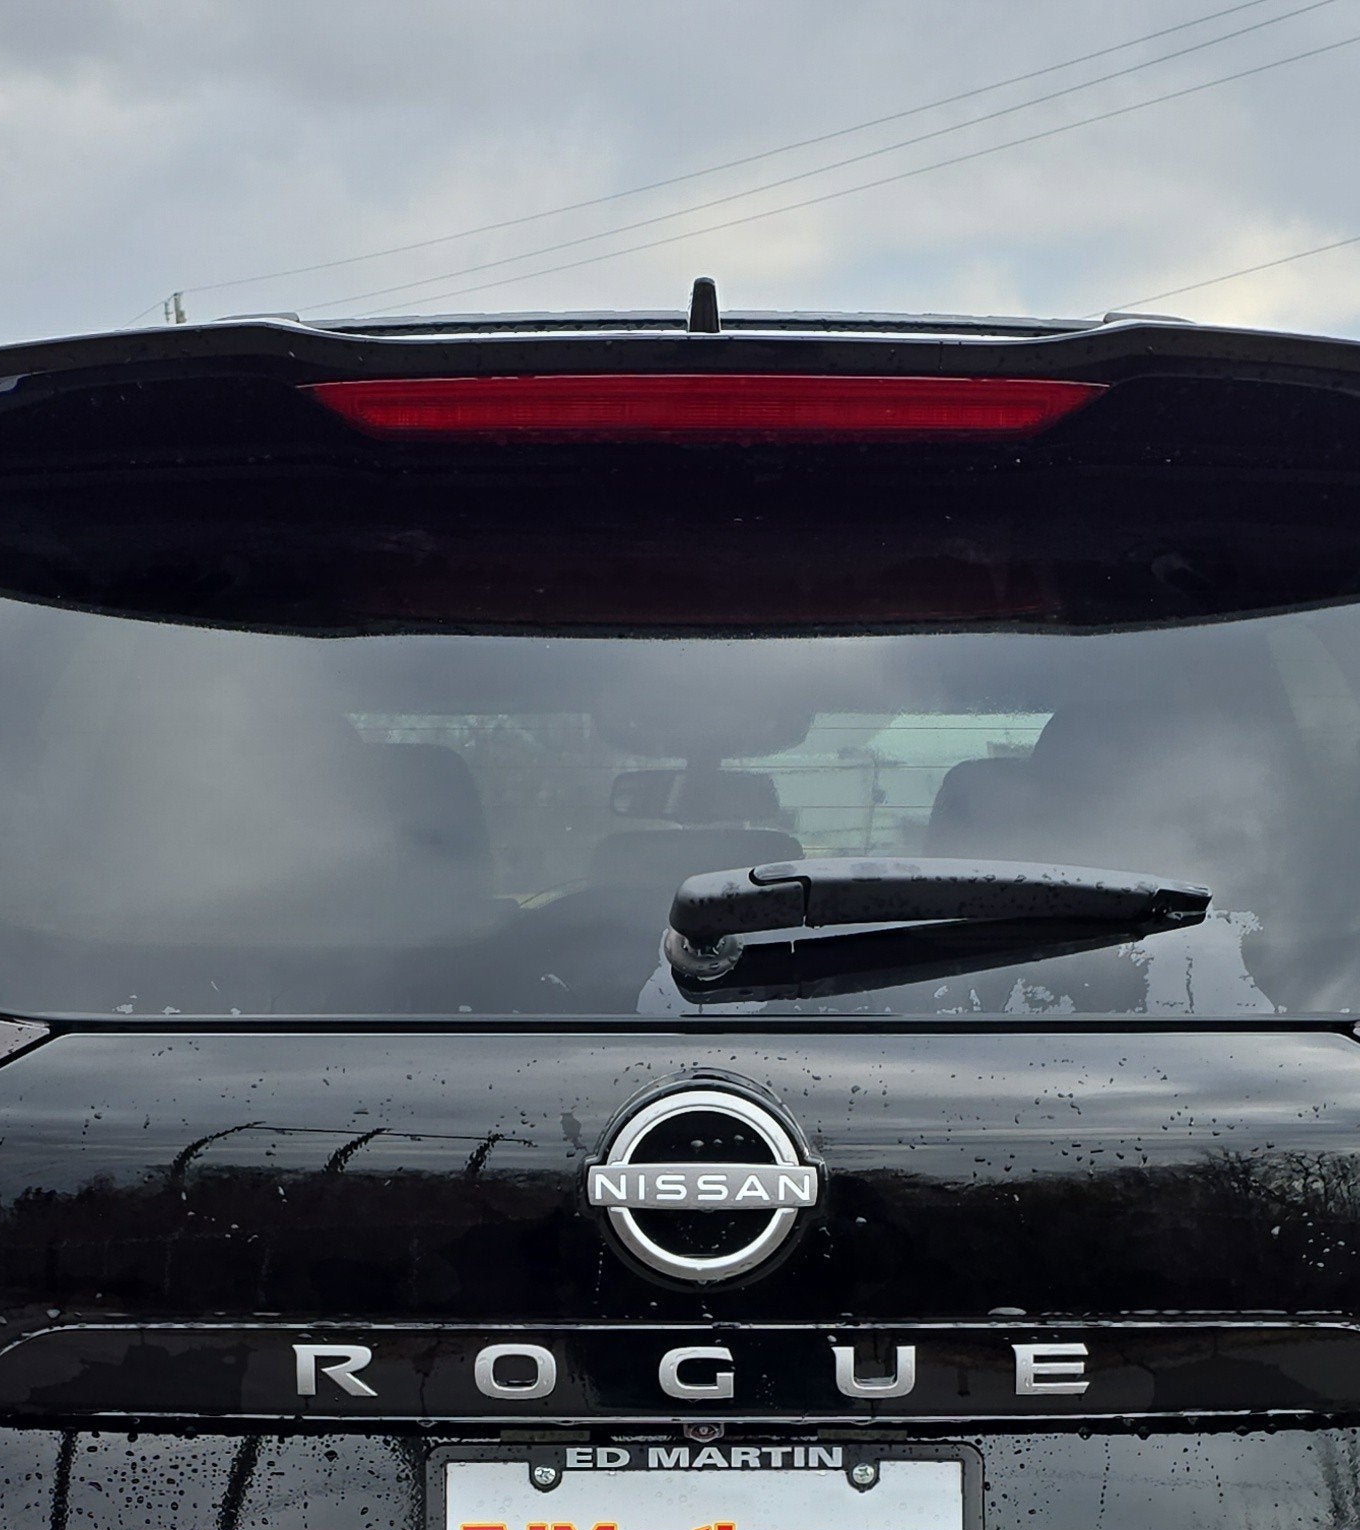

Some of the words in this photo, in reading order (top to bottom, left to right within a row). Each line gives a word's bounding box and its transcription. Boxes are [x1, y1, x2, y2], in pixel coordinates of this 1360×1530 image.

[594, 1172, 812, 1201] NISSAN
[292, 1341, 1091, 1399] ROGUE
[564, 1446, 631, 1468] ED
[647, 1445, 843, 1468] MARTIN
